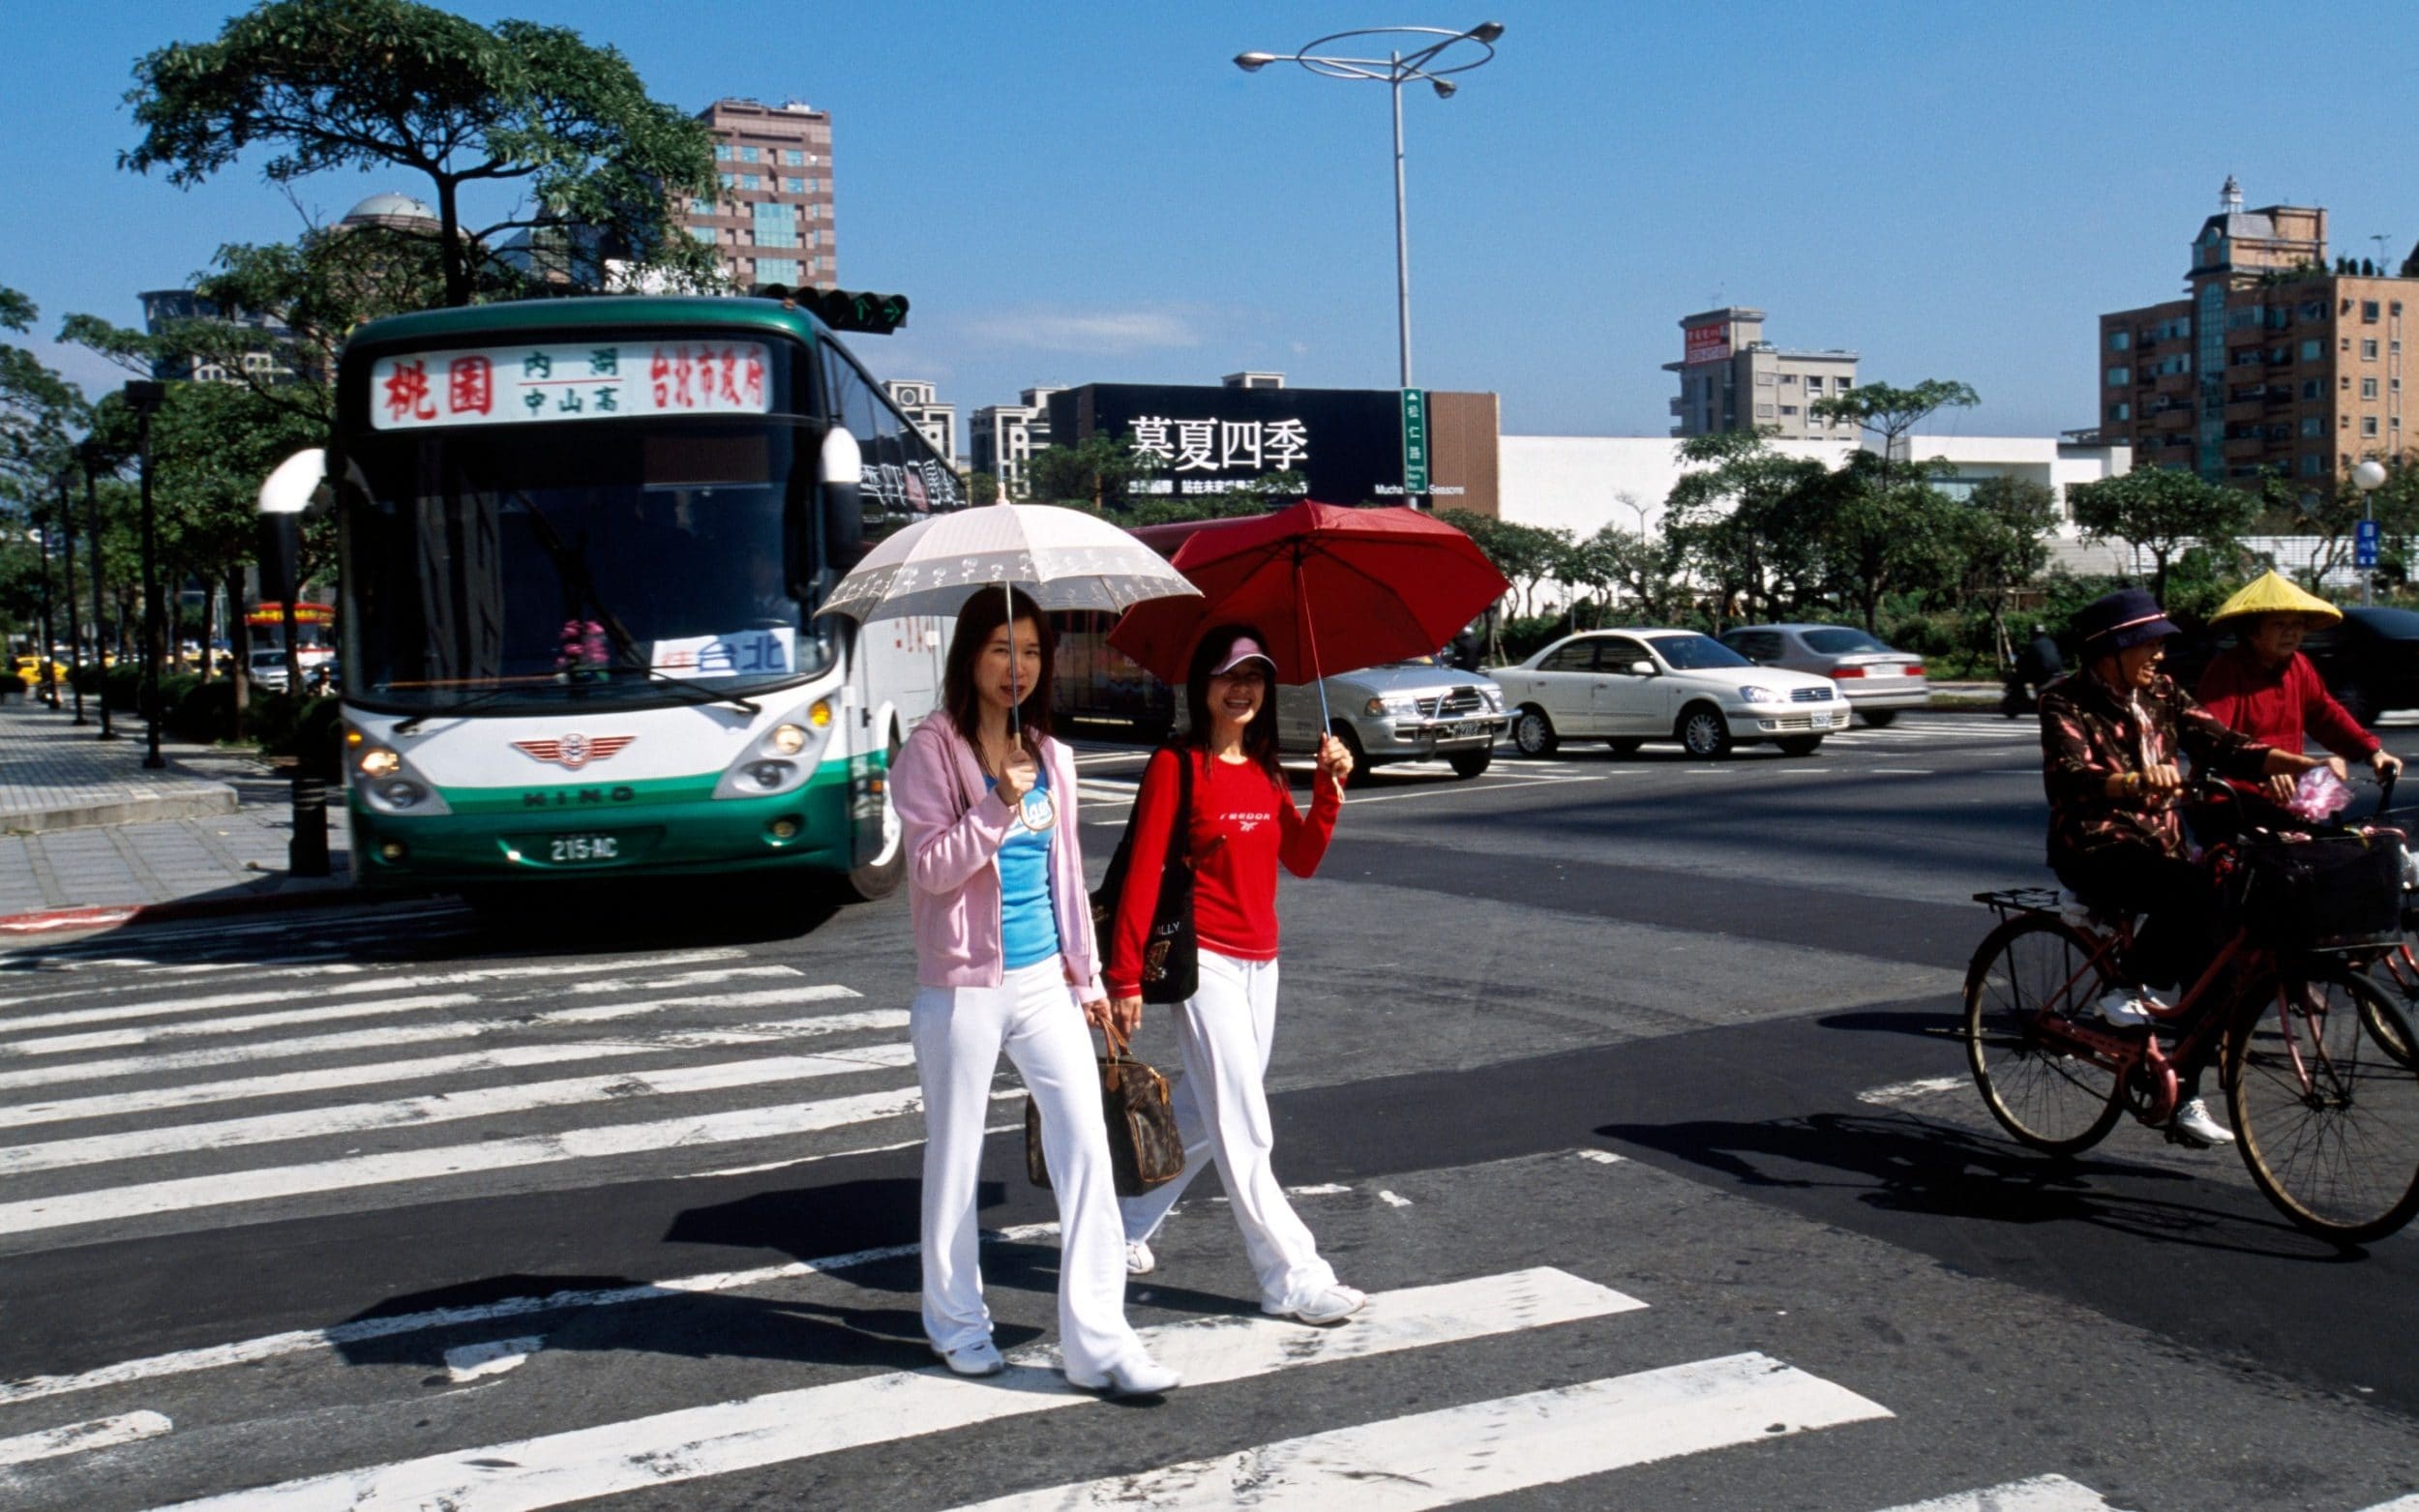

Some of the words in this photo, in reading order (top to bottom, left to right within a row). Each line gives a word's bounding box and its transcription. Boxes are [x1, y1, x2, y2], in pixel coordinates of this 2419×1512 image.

[384, 355, 493, 422] 桃園
[523, 385, 618, 417] 中山高
